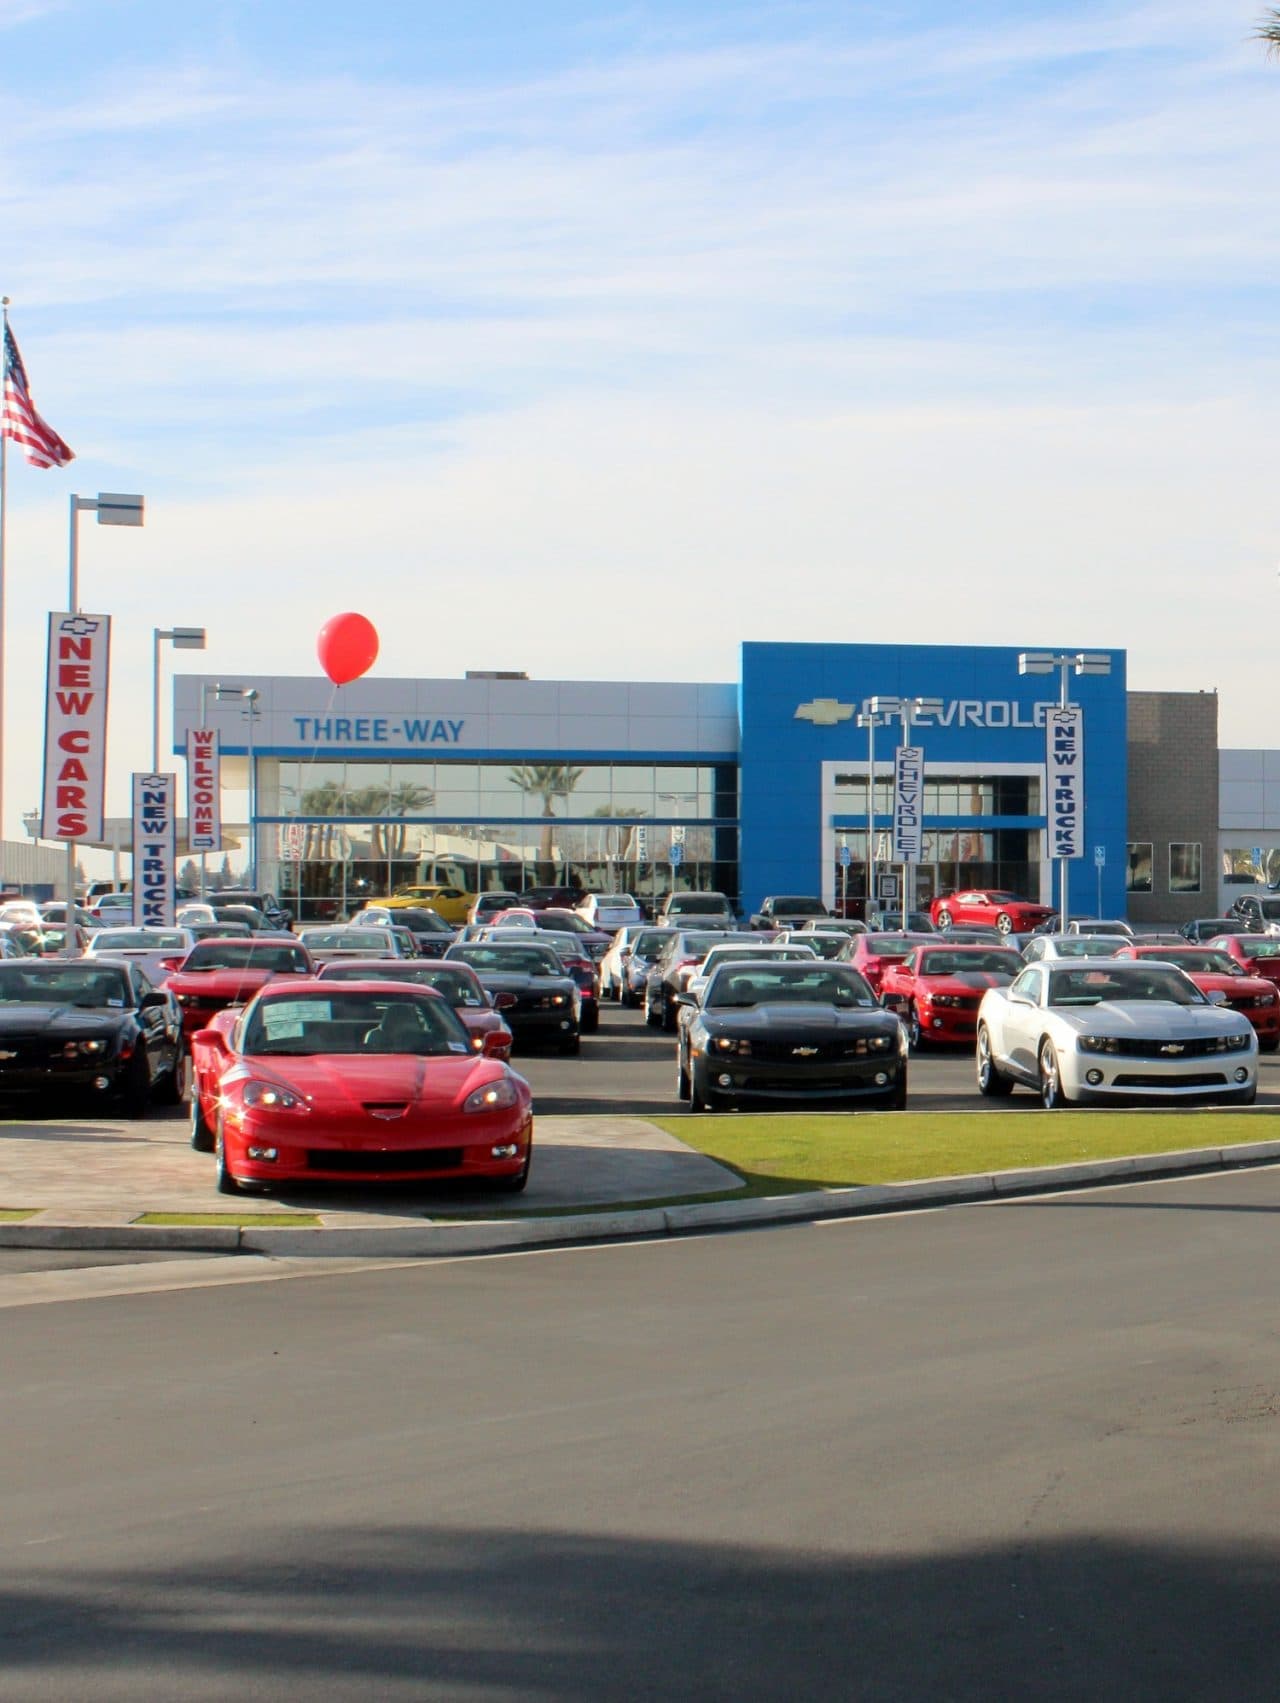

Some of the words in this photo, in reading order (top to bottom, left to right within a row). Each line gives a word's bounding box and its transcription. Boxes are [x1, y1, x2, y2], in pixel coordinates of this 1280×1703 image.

[56, 636, 95, 715] NEW
[293, 717, 465, 743] THREE-WAY
[1053, 725, 1077, 766] NEW
[56, 730, 89, 837] CARS
[141, 791, 168, 834] NEW
[193, 730, 214, 834] WELCOME
[897, 759, 919, 862] CHEVROLET
[1055, 775, 1075, 856] TRUCKS
